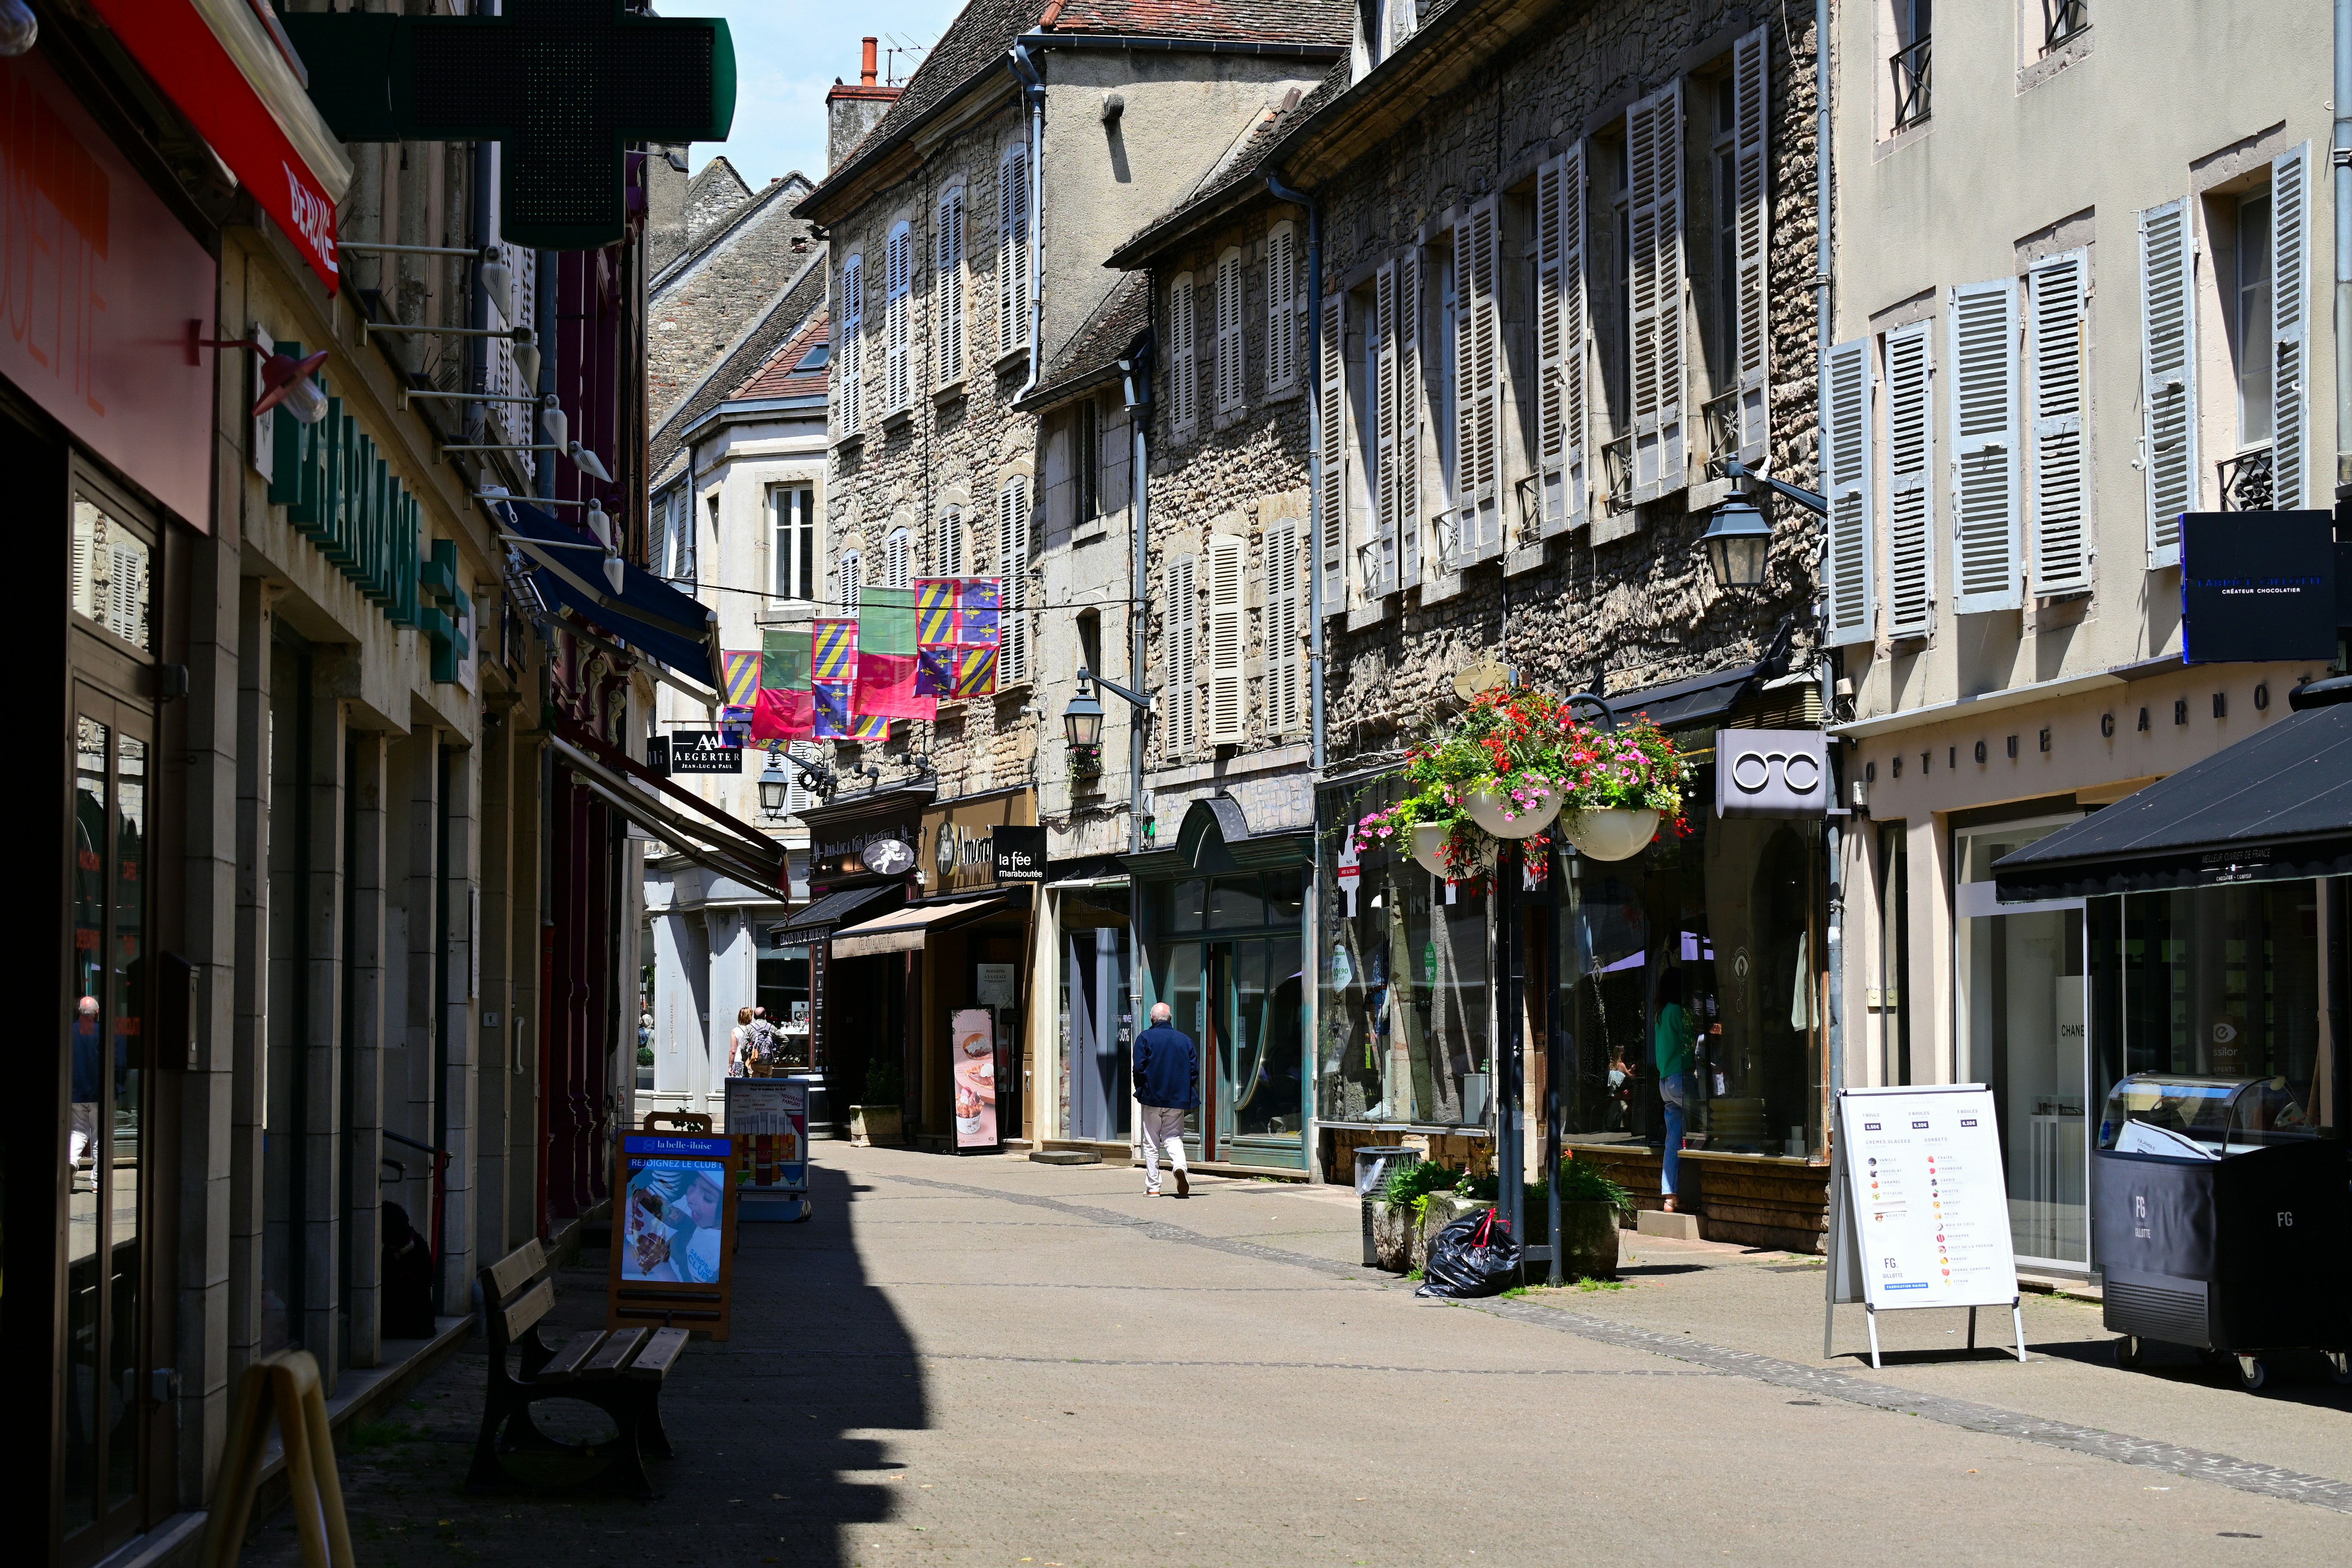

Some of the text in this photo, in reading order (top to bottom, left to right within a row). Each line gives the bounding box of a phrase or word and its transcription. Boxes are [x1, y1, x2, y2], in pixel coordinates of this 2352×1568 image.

[282, 159, 338, 273] BEAUNE
[270, 341, 422, 630] PHARMACIE
[2198, 576, 2323, 587] FABRICE GILLOTTE
[1865, 728, 2050, 783] OPTIQUE
[2101, 675, 2312, 738] CARNO
[674, 751, 740, 761] AEGERTER
[999, 852, 1031, 871] la fée
[2202, 853, 2222, 863] MEILLEUR
[2244, 850, 2251, 859] DE
[2252, 848, 2270, 858] FRANCE
[999, 869, 1043, 877] maraboutée
[780, 932, 794, 945] GRANDS
[803, 931, 808, 942] DE
[808, 926, 830, 941] BOURGOGNE
[859, 936, 896, 950] GELATO AL NATURALE
[1122, 1012, 1132, 1022] PRIVÉE
[2061, 1024, 2084, 1037] CHANE
[2213, 1047, 2238, 1056] ssilor
[781, 1093, 804, 1102] NOUVEAUX
[782, 1099, 800, 1107] PARFUMS
[657, 1140, 712, 1150] la belle-iloise
[632, 1159, 679, 1168] REJOIGNEZ
[2277, 1211, 2292, 1227] FG
[688, 1255, 709, 1279] CLUB
[1884, 1258, 1898, 1269] FG.
